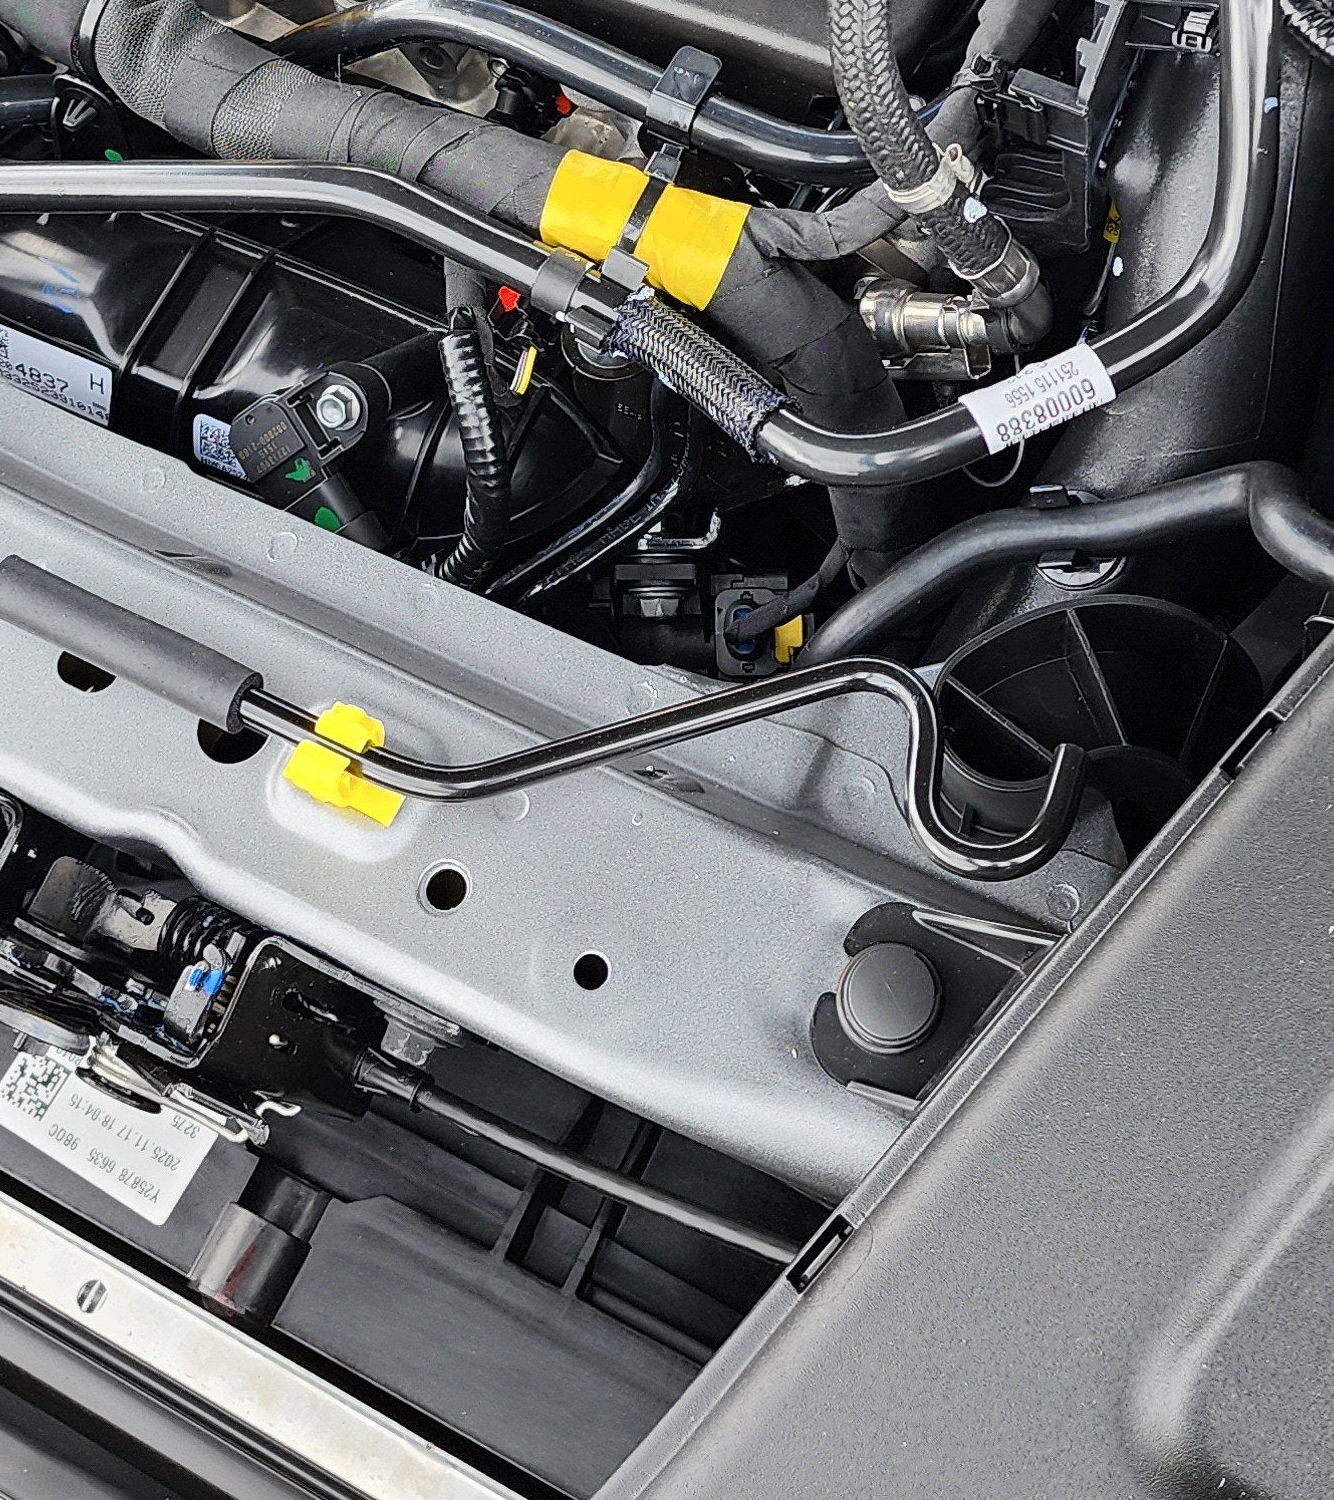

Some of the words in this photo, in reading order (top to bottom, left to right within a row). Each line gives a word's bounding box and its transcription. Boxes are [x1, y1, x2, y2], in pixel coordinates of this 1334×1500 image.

[89, 372, 106, 395] H
[1033, 360, 1080, 394] 251115
[995, 377, 1097, 443] 60008388
[1004, 382, 1035, 409] 1556
[68, 1093, 119, 1132] 18:04:15
[170, 1113, 201, 1140] 3275
[85, 1146, 117, 1174] 6635
[116, 1124, 182, 1172] 2025.11.17
[117, 1167, 161, 1204] Y25878
